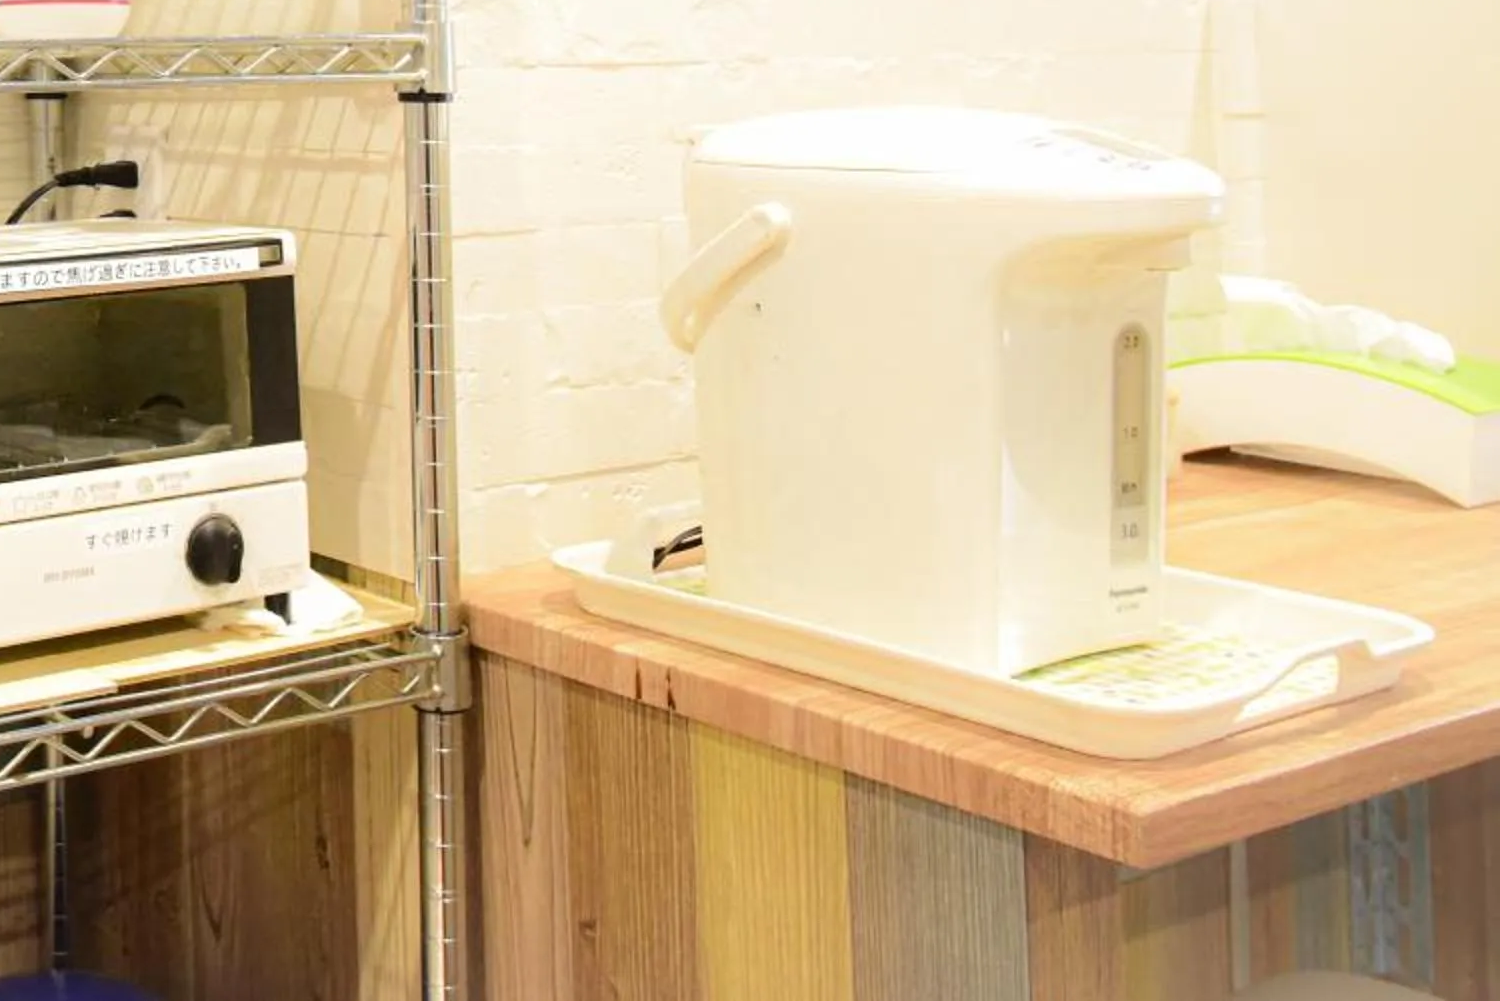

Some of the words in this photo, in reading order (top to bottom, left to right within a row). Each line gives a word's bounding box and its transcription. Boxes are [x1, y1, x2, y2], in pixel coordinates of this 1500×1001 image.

[85, 523, 173, 550] すぐ焼けます
